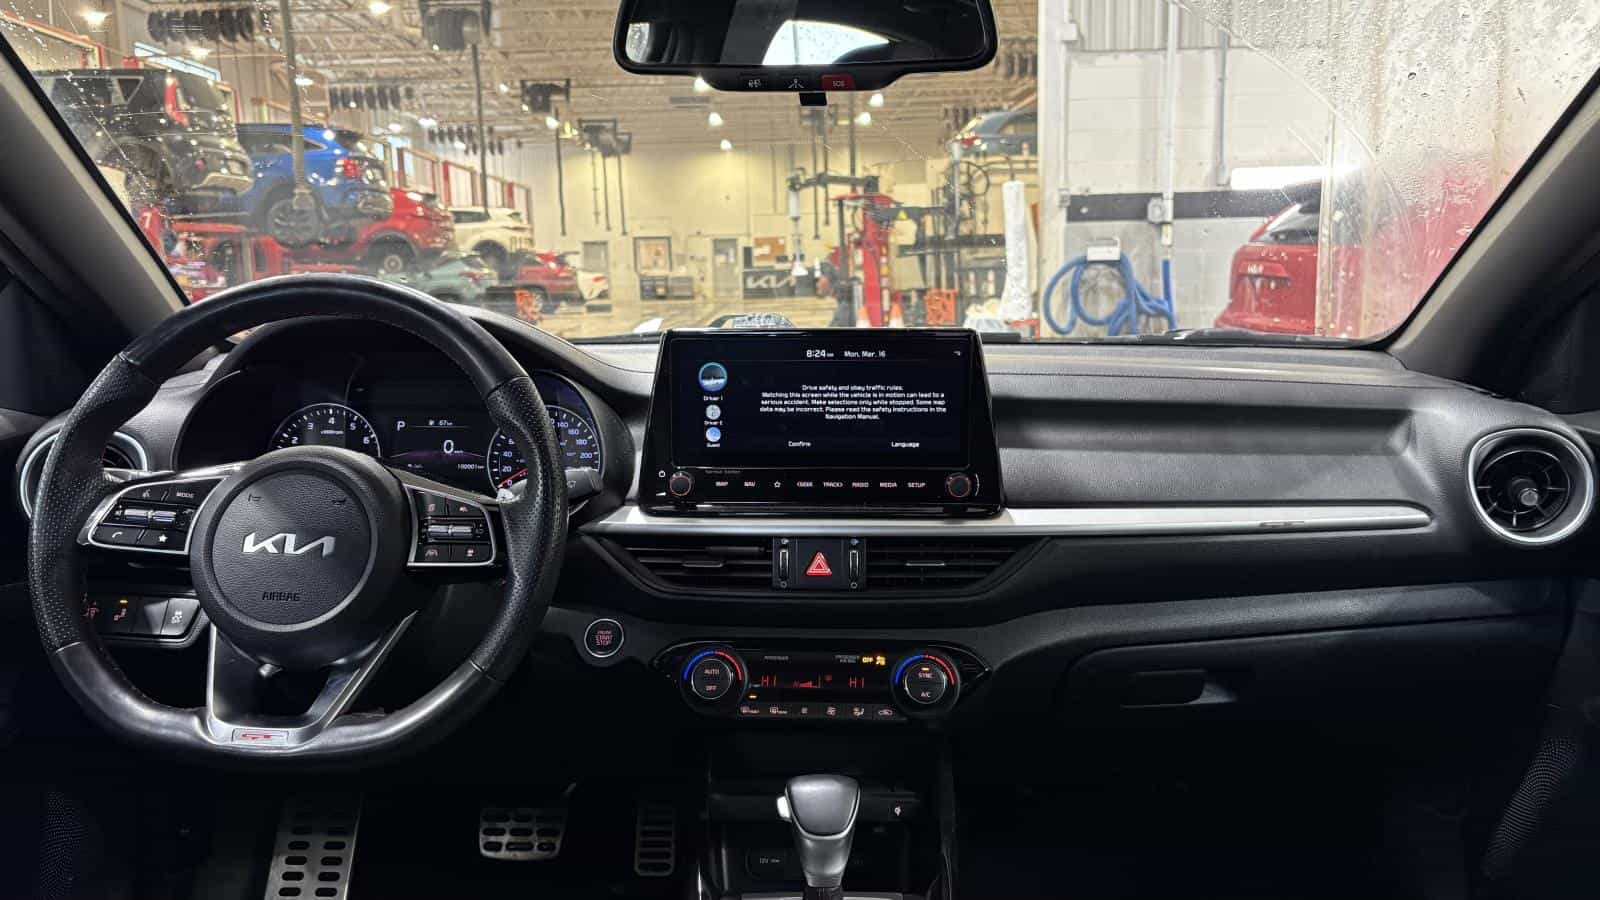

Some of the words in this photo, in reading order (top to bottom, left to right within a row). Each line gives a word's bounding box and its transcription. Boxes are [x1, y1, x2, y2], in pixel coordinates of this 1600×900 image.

[806, 349, 826, 358] 8:24
[350, 422, 356, 430] 5
[396, 420, 406, 431] P
[292, 436, 299, 444] 2
[362, 436, 370, 444] 6
[443, 440, 454, 454] 0
[262, 592, 300, 601] AIRBAG
